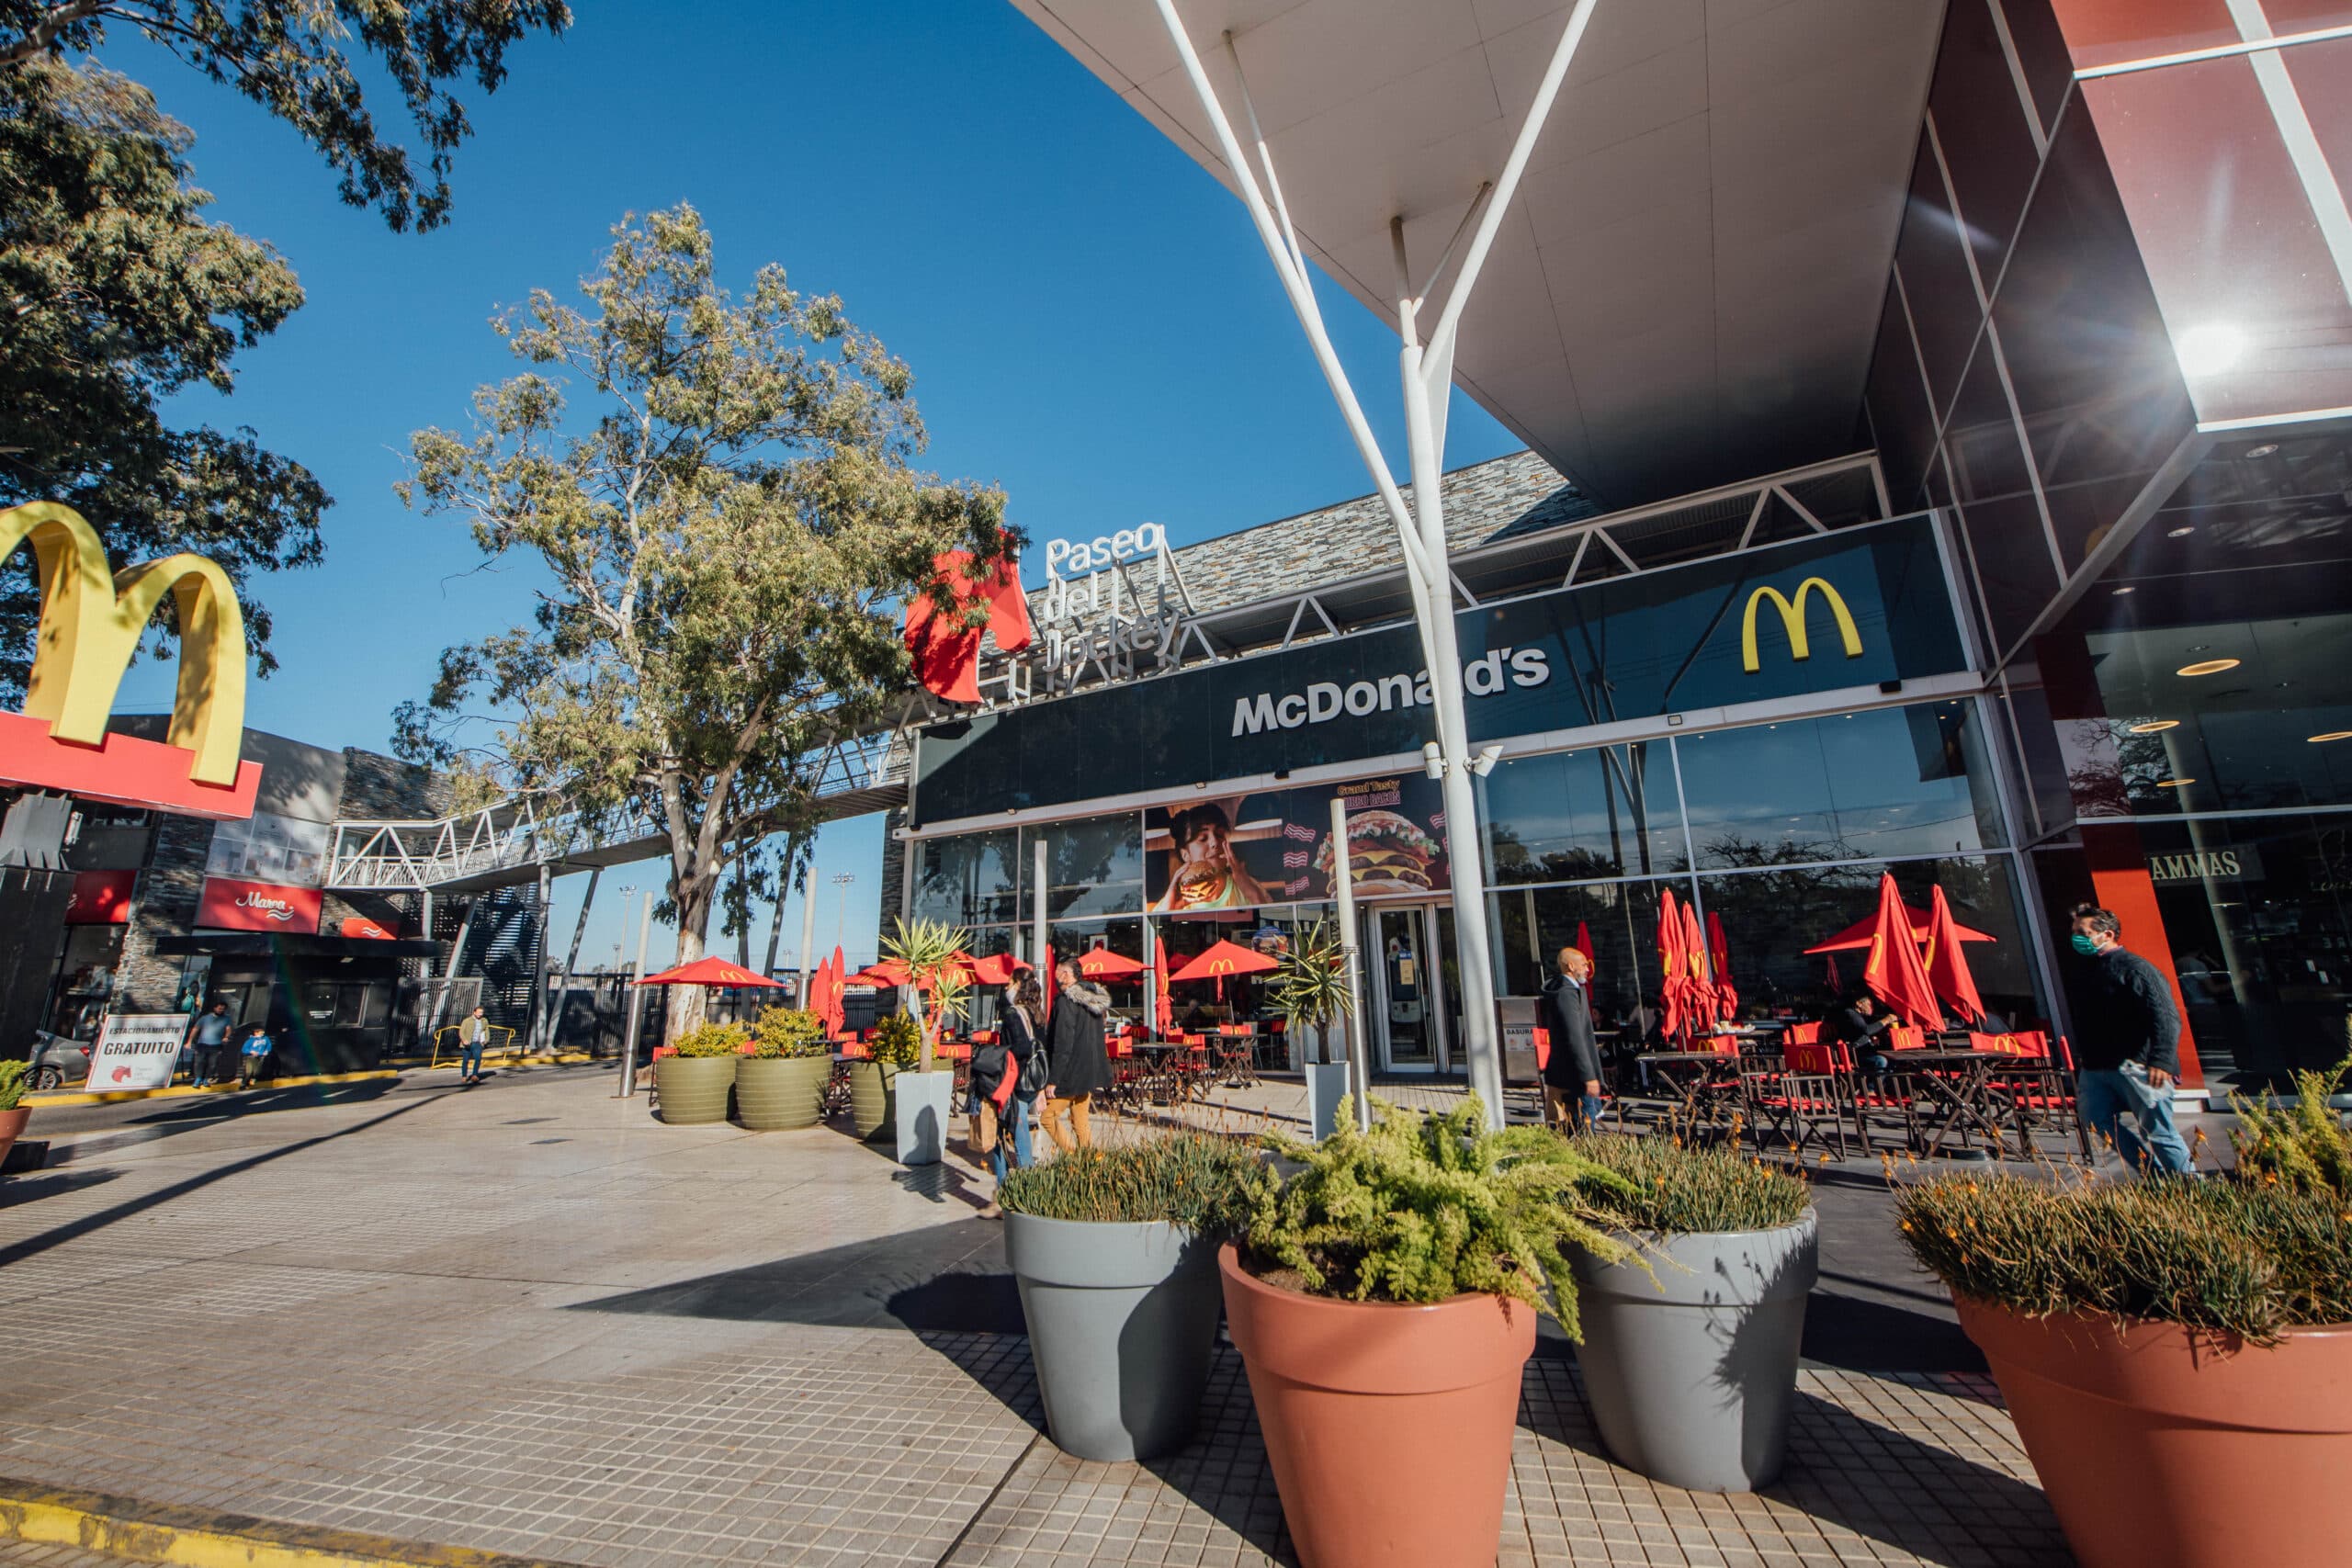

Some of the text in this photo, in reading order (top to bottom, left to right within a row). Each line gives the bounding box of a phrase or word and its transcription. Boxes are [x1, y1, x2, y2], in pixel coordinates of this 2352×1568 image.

[1046, 523, 1165, 580] Paseo
[1044, 570, 1101, 623] del
[1043, 611, 1182, 671] Jockey
[1232, 647, 1550, 738] McDonad's
[1338, 779, 1401, 795] Grand Tasty
[1344, 795, 1369, 808] URBO
[109, 1026, 180, 1035] ESTACIONAMIENTO
[104, 1041, 175, 1055] GRATUITO
